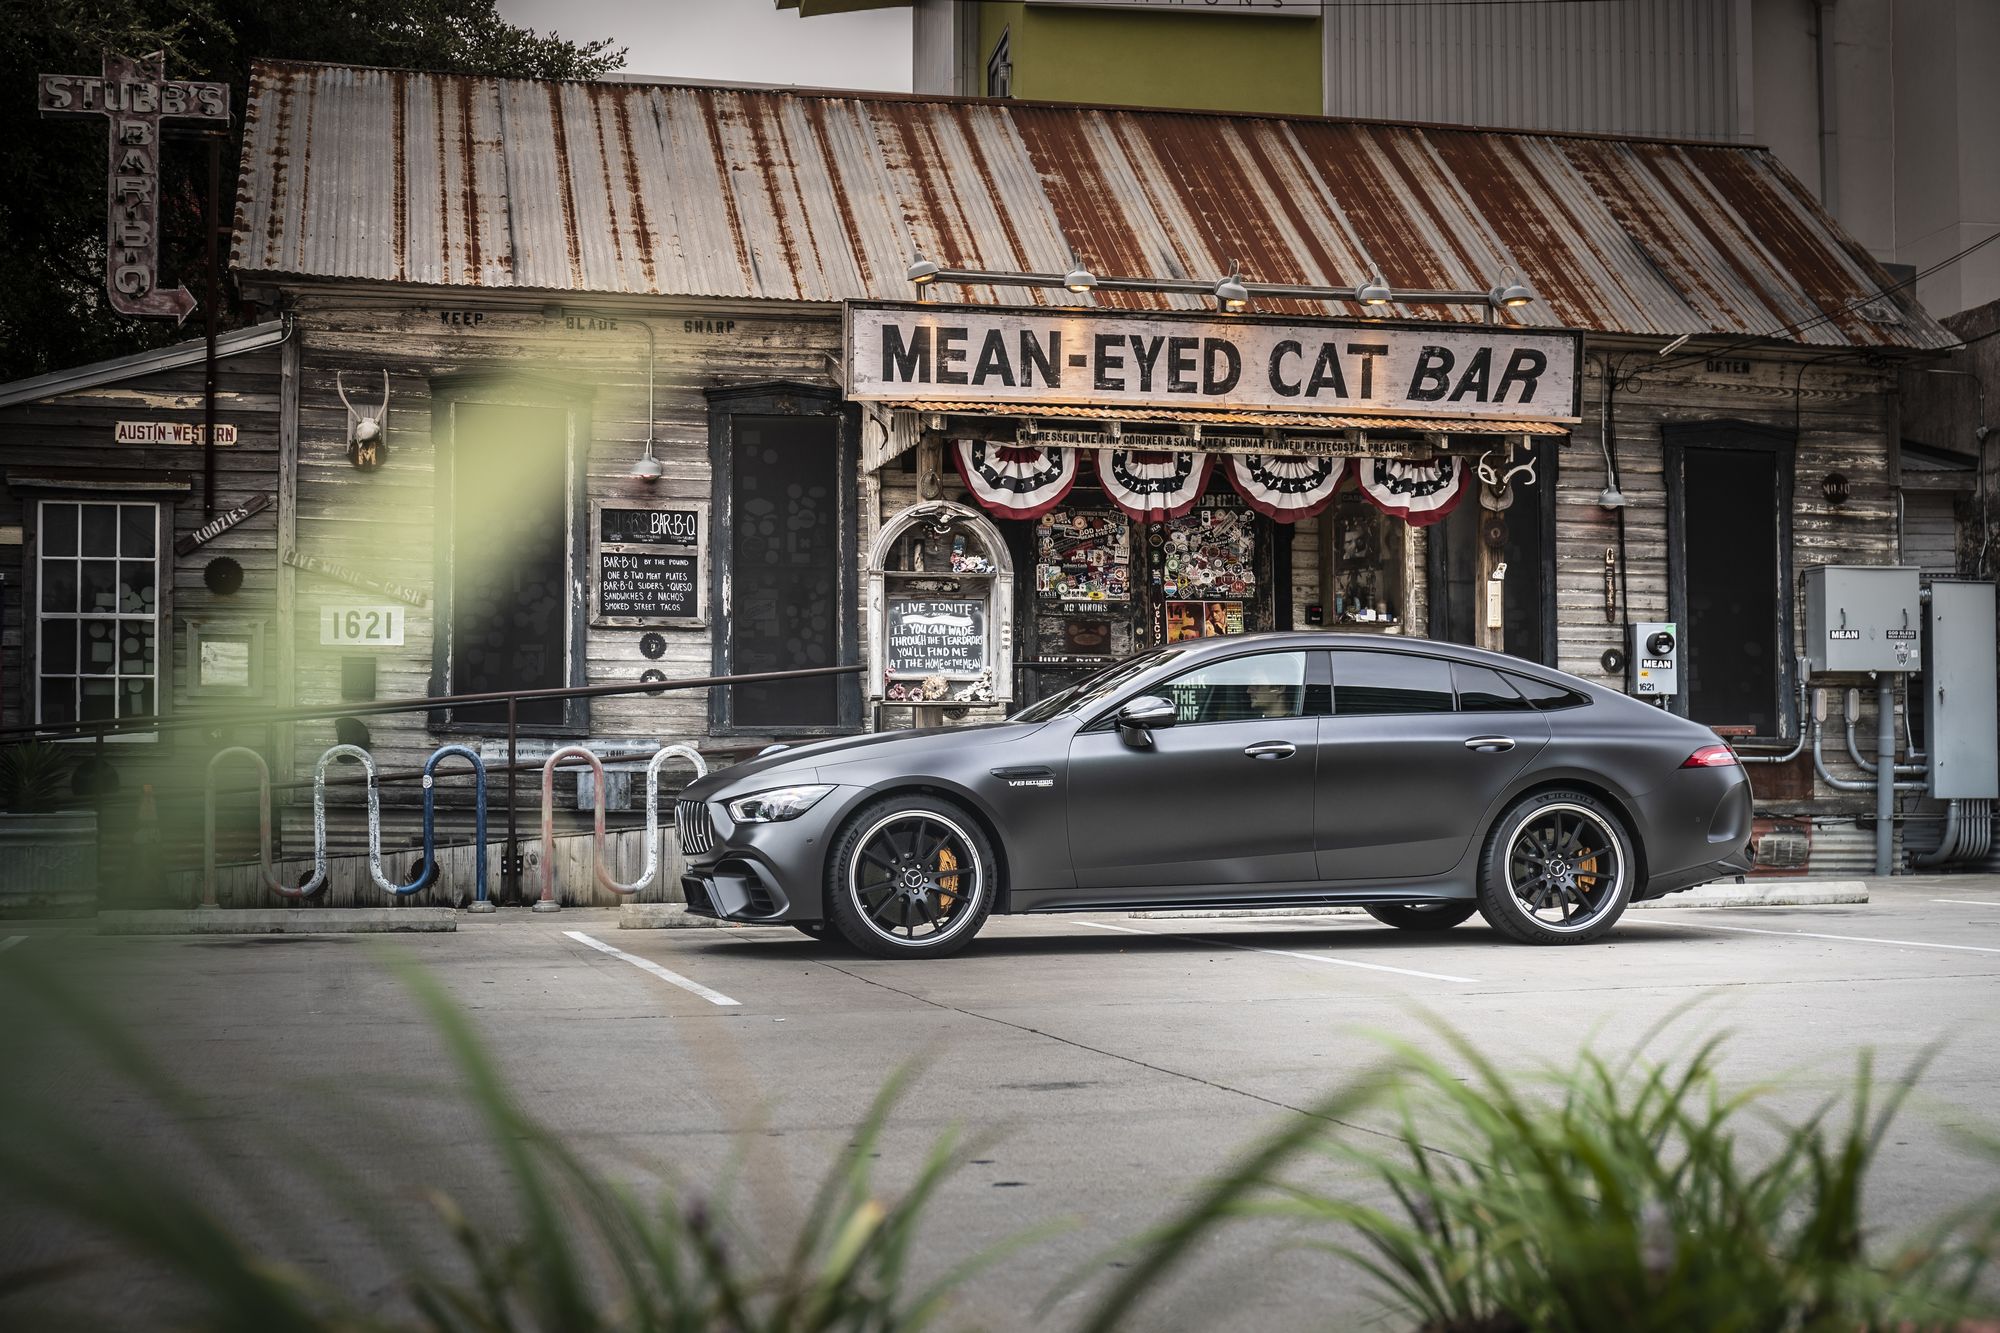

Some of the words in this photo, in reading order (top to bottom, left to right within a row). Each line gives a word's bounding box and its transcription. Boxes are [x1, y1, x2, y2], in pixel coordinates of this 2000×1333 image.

[45, 77, 224, 115] STUBB'S
[440, 311, 484, 325] KEEP
[565, 317, 618, 331] BLADE
[684, 319, 735, 334] SHARP
[881, 324, 1242, 396] MEAN-EYED
[1267, 339, 1389, 400] CAT
[1406, 345, 1548, 404] BAR
[1706, 360, 1750, 374] OFTEN
[118, 424, 234, 442] AUSTIN-WESTRN
[1076, 433, 1097, 443] LIKE
[1099, 434, 1105, 443] A
[1123, 435, 1164, 446] CORONER
[1167, 437, 1172, 446] &
[1174, 437, 1197, 447] SANG
[1230, 438, 1264, 448] GUNMAN
[1267, 440, 1300, 450] TURNED
[1304, 441, 1366, 452] PENTECOSTAL
[1823, 483, 1850, 495] MOJO
[192, 507, 249, 544] KOOZIES
[650, 512, 696, 536] BAR-B-Q
[283, 550, 316, 568] LIVE
[384, 582, 422, 604] CASH
[607, 570, 621, 580] ONE
[623, 570, 629, 580] &
[630, 571, 644, 580] TWO
[645, 572, 662, 580] MEAT
[665, 572, 688, 581] PLATES
[637, 582, 664, 591] SLIDERS
[603, 592, 645, 601] SANDWICHES
[647, 592, 653, 601] &
[657, 592, 684, 602] NACHOS
[604, 603, 630, 611] SMOKED
[633, 603, 656, 611] STREET
[659, 603, 681, 611] TACOS
[901, 603, 926, 614] LIVE
[930, 603, 972, 616] TONITE
[1063, 603, 1075, 612] NO
[1077, 603, 1108, 612] MINORS
[333, 610, 392, 639] 1621
[909, 624, 927, 635] YOU
[928, 625, 946, 635] CAN
[948, 626, 975, 636] WADE
[891, 635, 927, 647] THROUGH
[927, 636, 941, 645] THE
[942, 635, 983, 646] TEARDROPS
[1831, 630, 1859, 639] MEAN
[897, 646, 926, 657] YOU'LL
[927, 647, 950, 657] FIND
[952, 648, 968, 657] ME
[890, 659, 902, 668] AT
[905, 659, 924, 668] THE
[925, 658, 944, 669] HOME
[1643, 659, 1672, 669] MEAN
[1639, 683, 1655, 691] 1621
[1172, 690, 1196, 705] THE
[1177, 705, 1200, 721] INE
